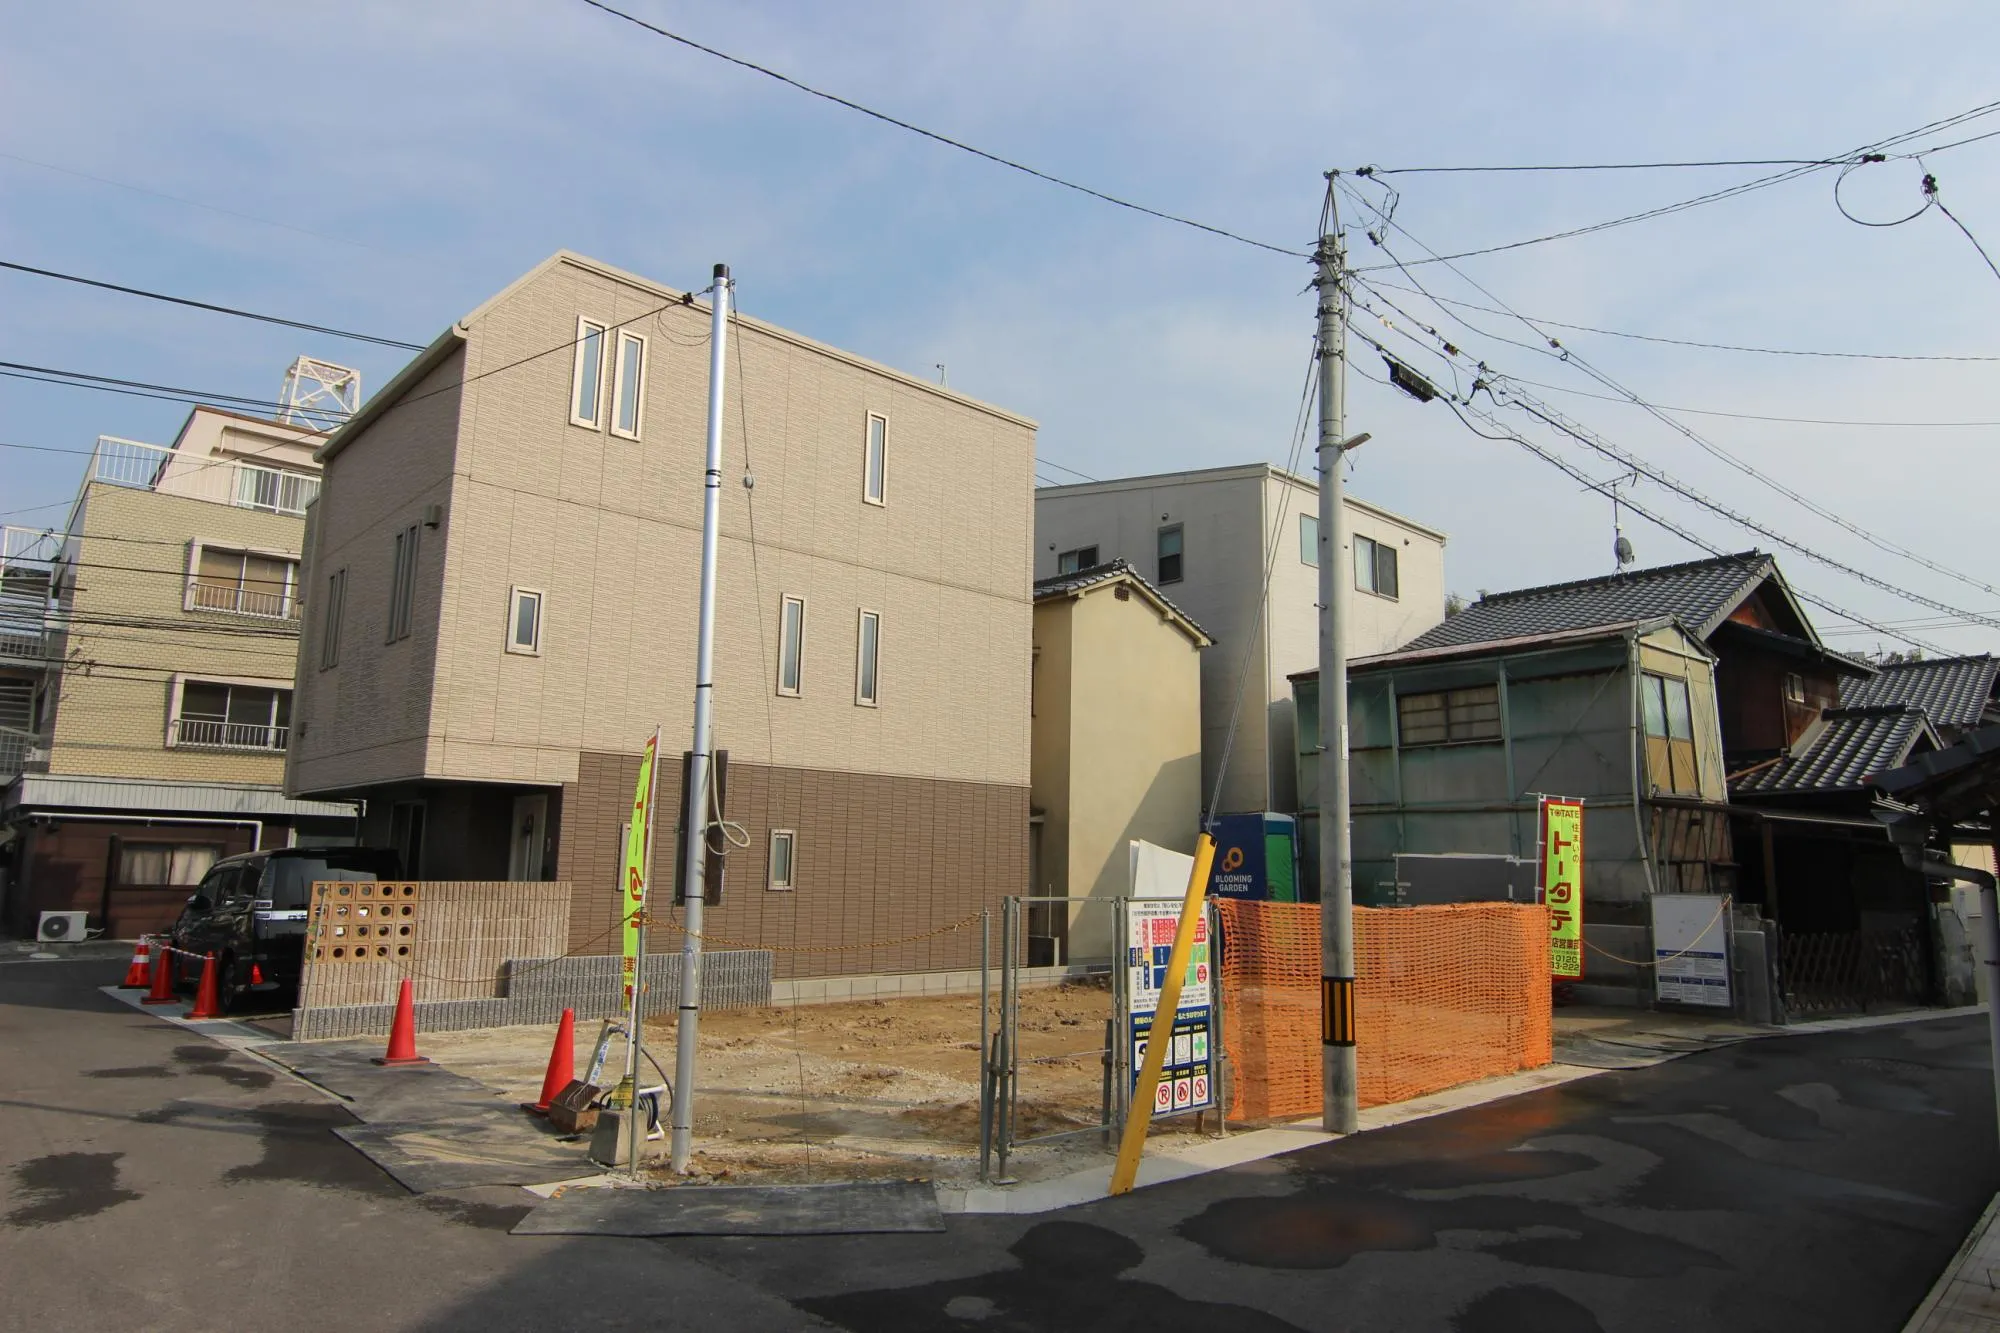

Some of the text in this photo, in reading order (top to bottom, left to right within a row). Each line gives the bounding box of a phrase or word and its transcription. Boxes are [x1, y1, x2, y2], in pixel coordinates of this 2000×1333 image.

[1549, 808, 1580, 818] TOTATE
[1572, 823, 1580, 863] 住まいの
[1215, 875, 1253, 883] BLOOMING
[1548, 831, 1573, 931] トータテ
[1219, 884, 1248, 892] GARDEN
